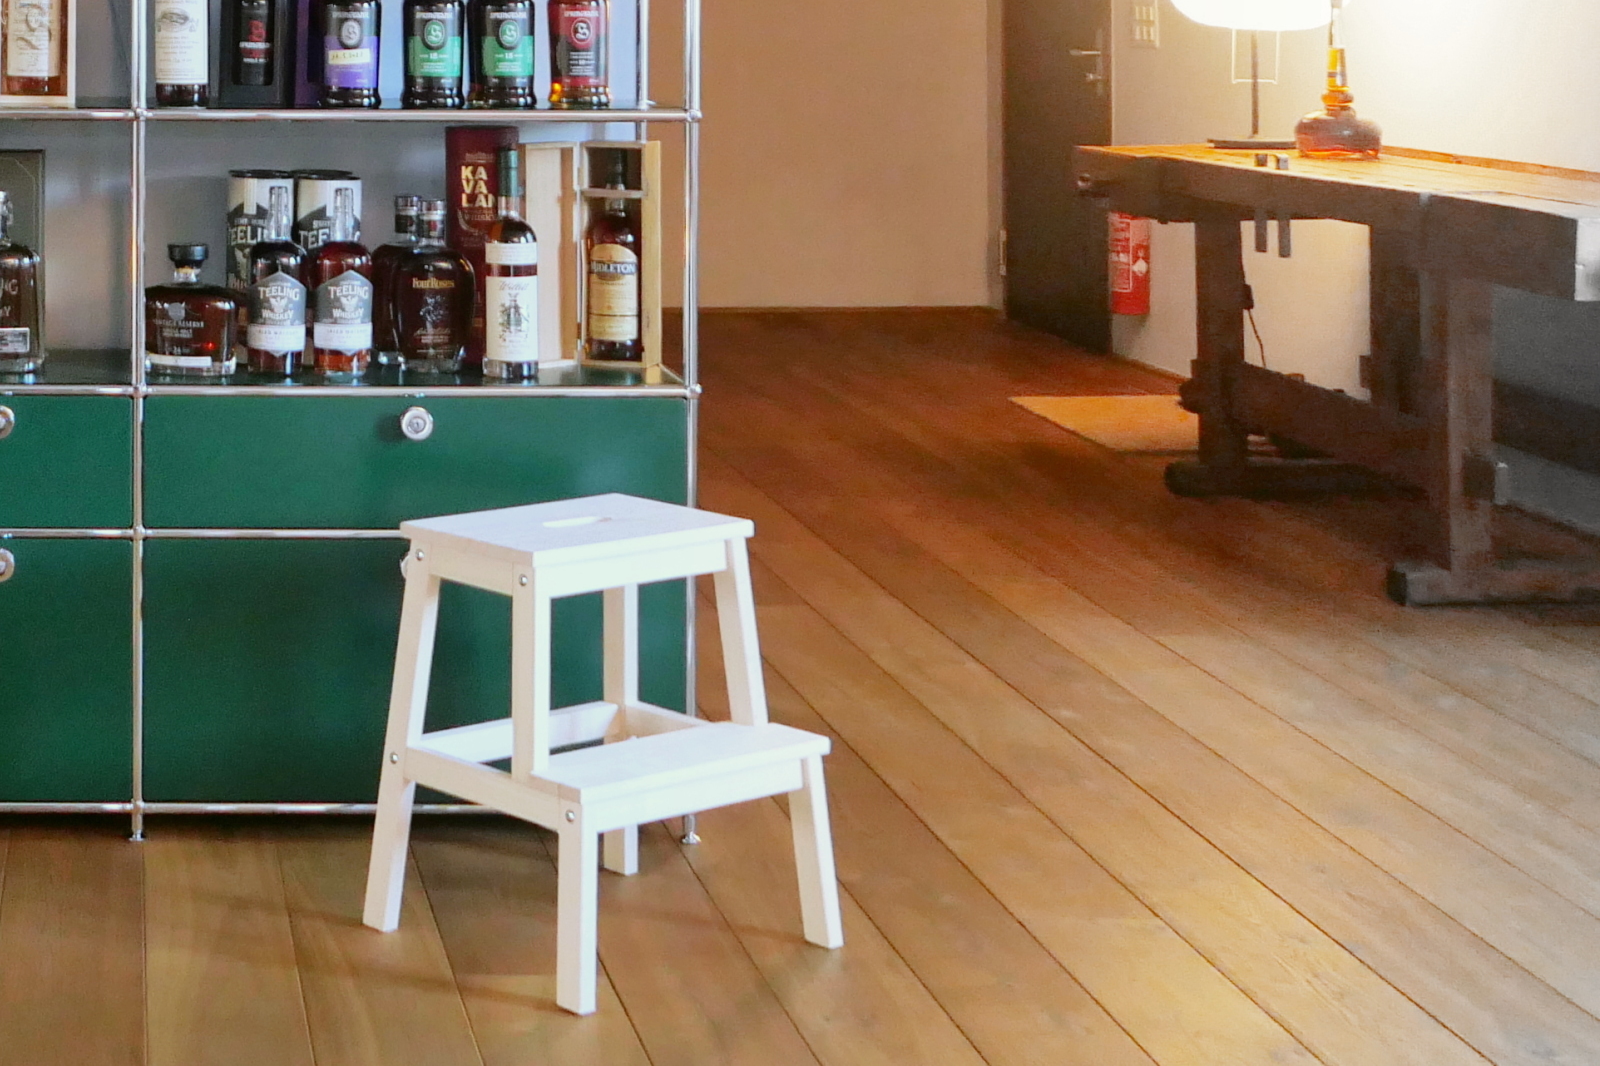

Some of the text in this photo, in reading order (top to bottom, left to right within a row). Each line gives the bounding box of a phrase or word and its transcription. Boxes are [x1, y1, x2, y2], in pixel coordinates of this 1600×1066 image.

[461, 165, 489, 181] KA
[461, 180, 489, 195] VA
[257, 285, 300, 301] TEELING
[328, 284, 369, 300] TEELING
[261, 308, 295, 320] WHISKEY
[332, 307, 365, 319] WHISKEY
